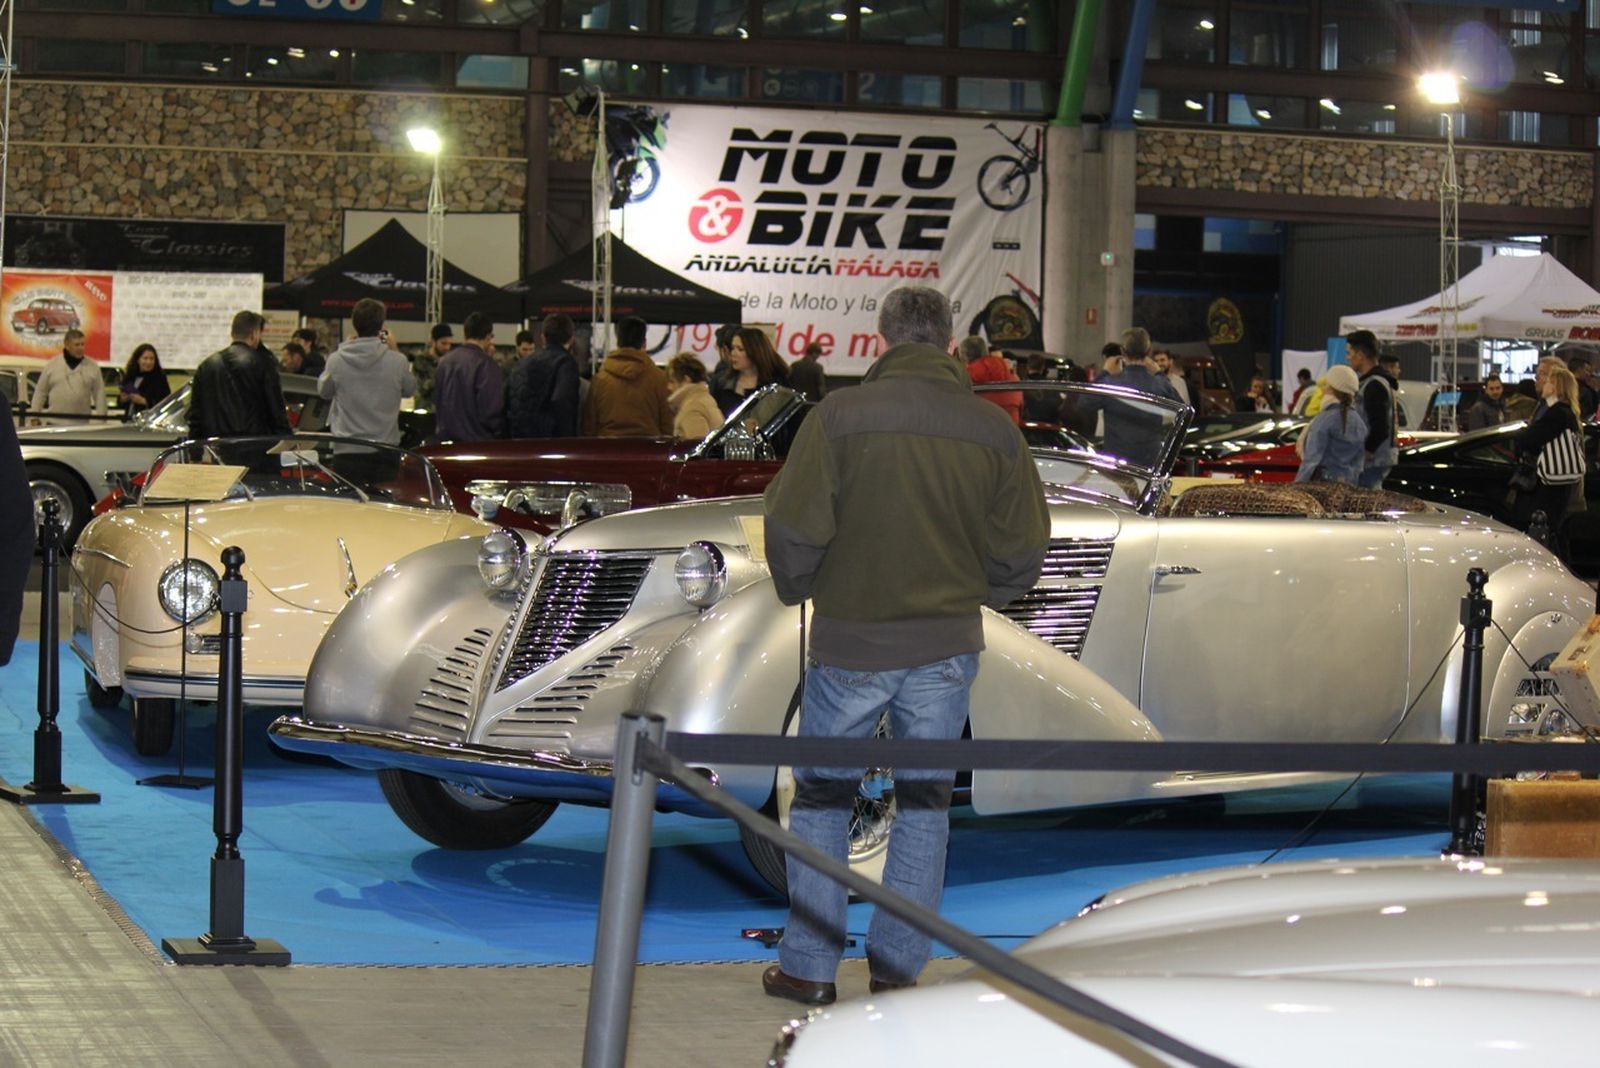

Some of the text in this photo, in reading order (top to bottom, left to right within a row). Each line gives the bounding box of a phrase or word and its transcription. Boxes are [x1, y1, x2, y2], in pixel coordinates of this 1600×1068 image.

[718, 127, 957, 190] MOTO
[695, 190, 956, 251] & BIKE
[139, 238, 252, 257] Classics
[684, 253, 940, 279] ANDALUCÍA MÁLAGA
[369, 277, 477, 293] Clasics
[738, 292, 877, 316] de la Moto y la
[675, 323, 712, 352] 19
[1525, 327, 1566, 339] GRUAS
